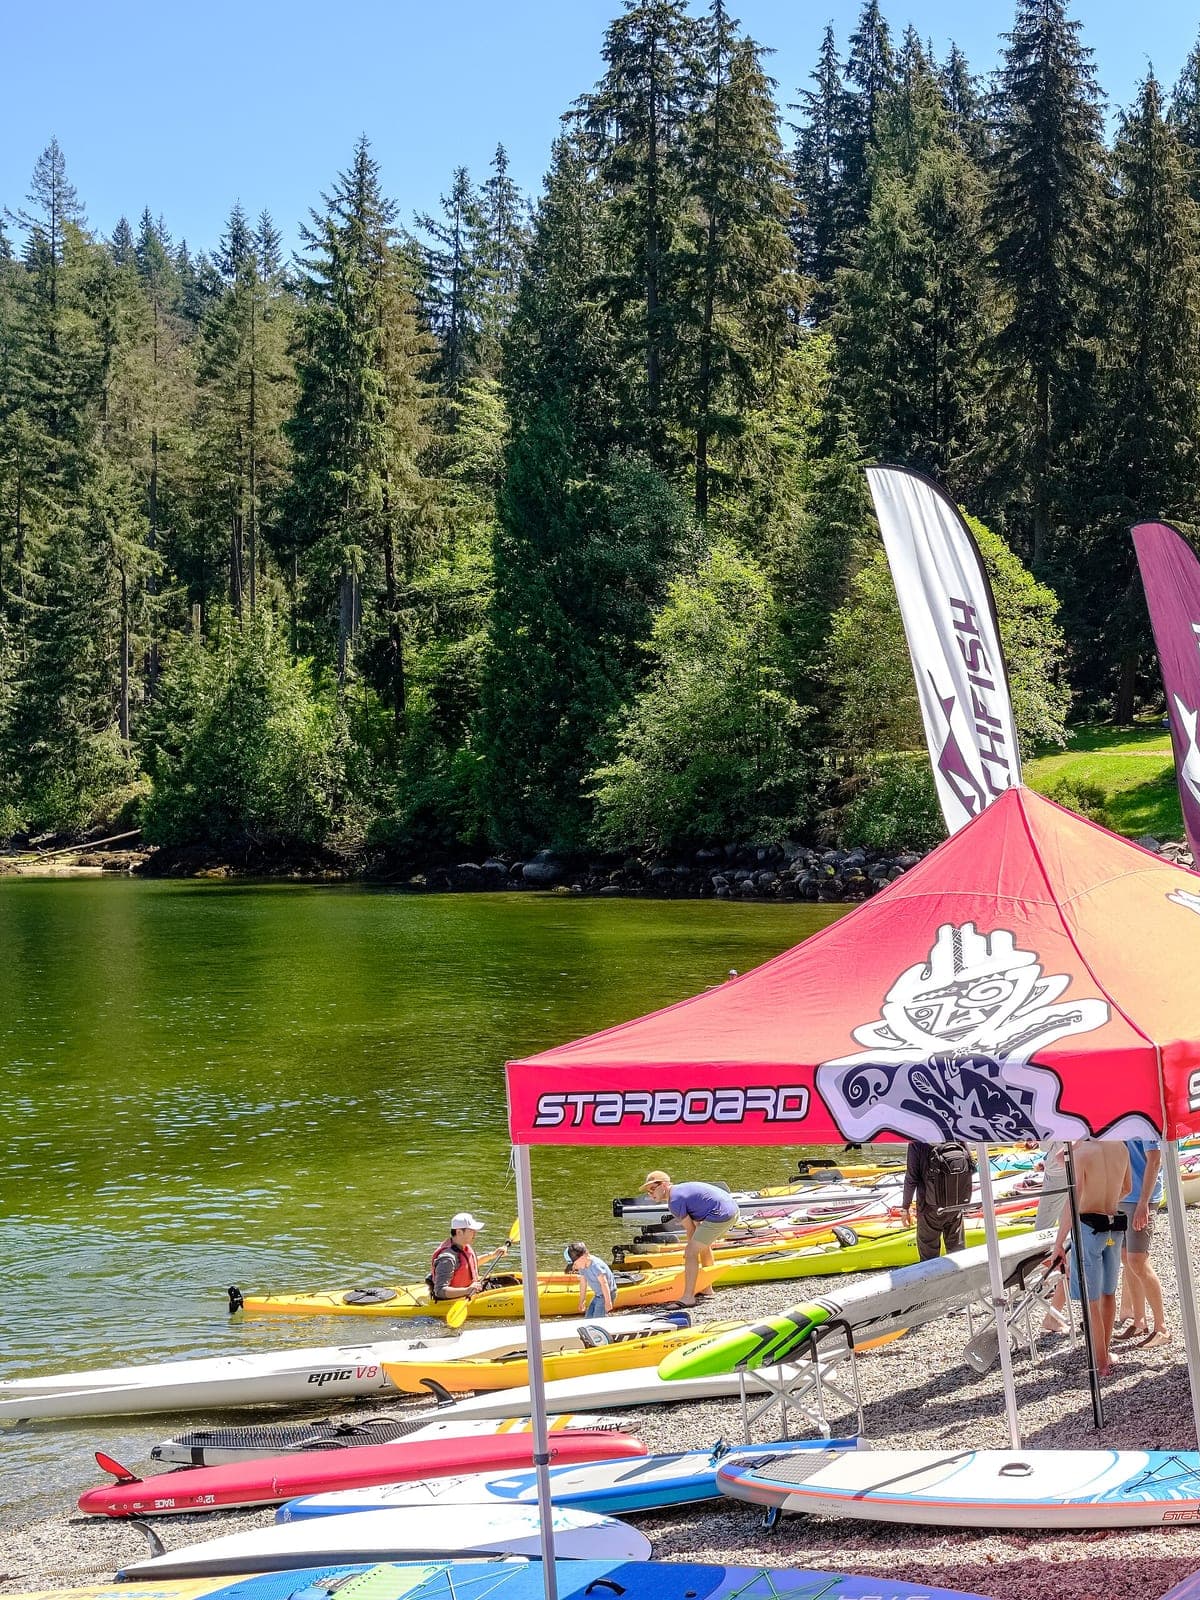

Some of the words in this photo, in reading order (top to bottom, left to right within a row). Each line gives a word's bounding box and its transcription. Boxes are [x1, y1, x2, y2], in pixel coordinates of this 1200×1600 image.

[533, 1085, 811, 1127] STARBOARD
[307, 1368, 353, 1387] epic
[356, 1365, 378, 1379] V8
[154, 1498, 175, 1509] RACE
